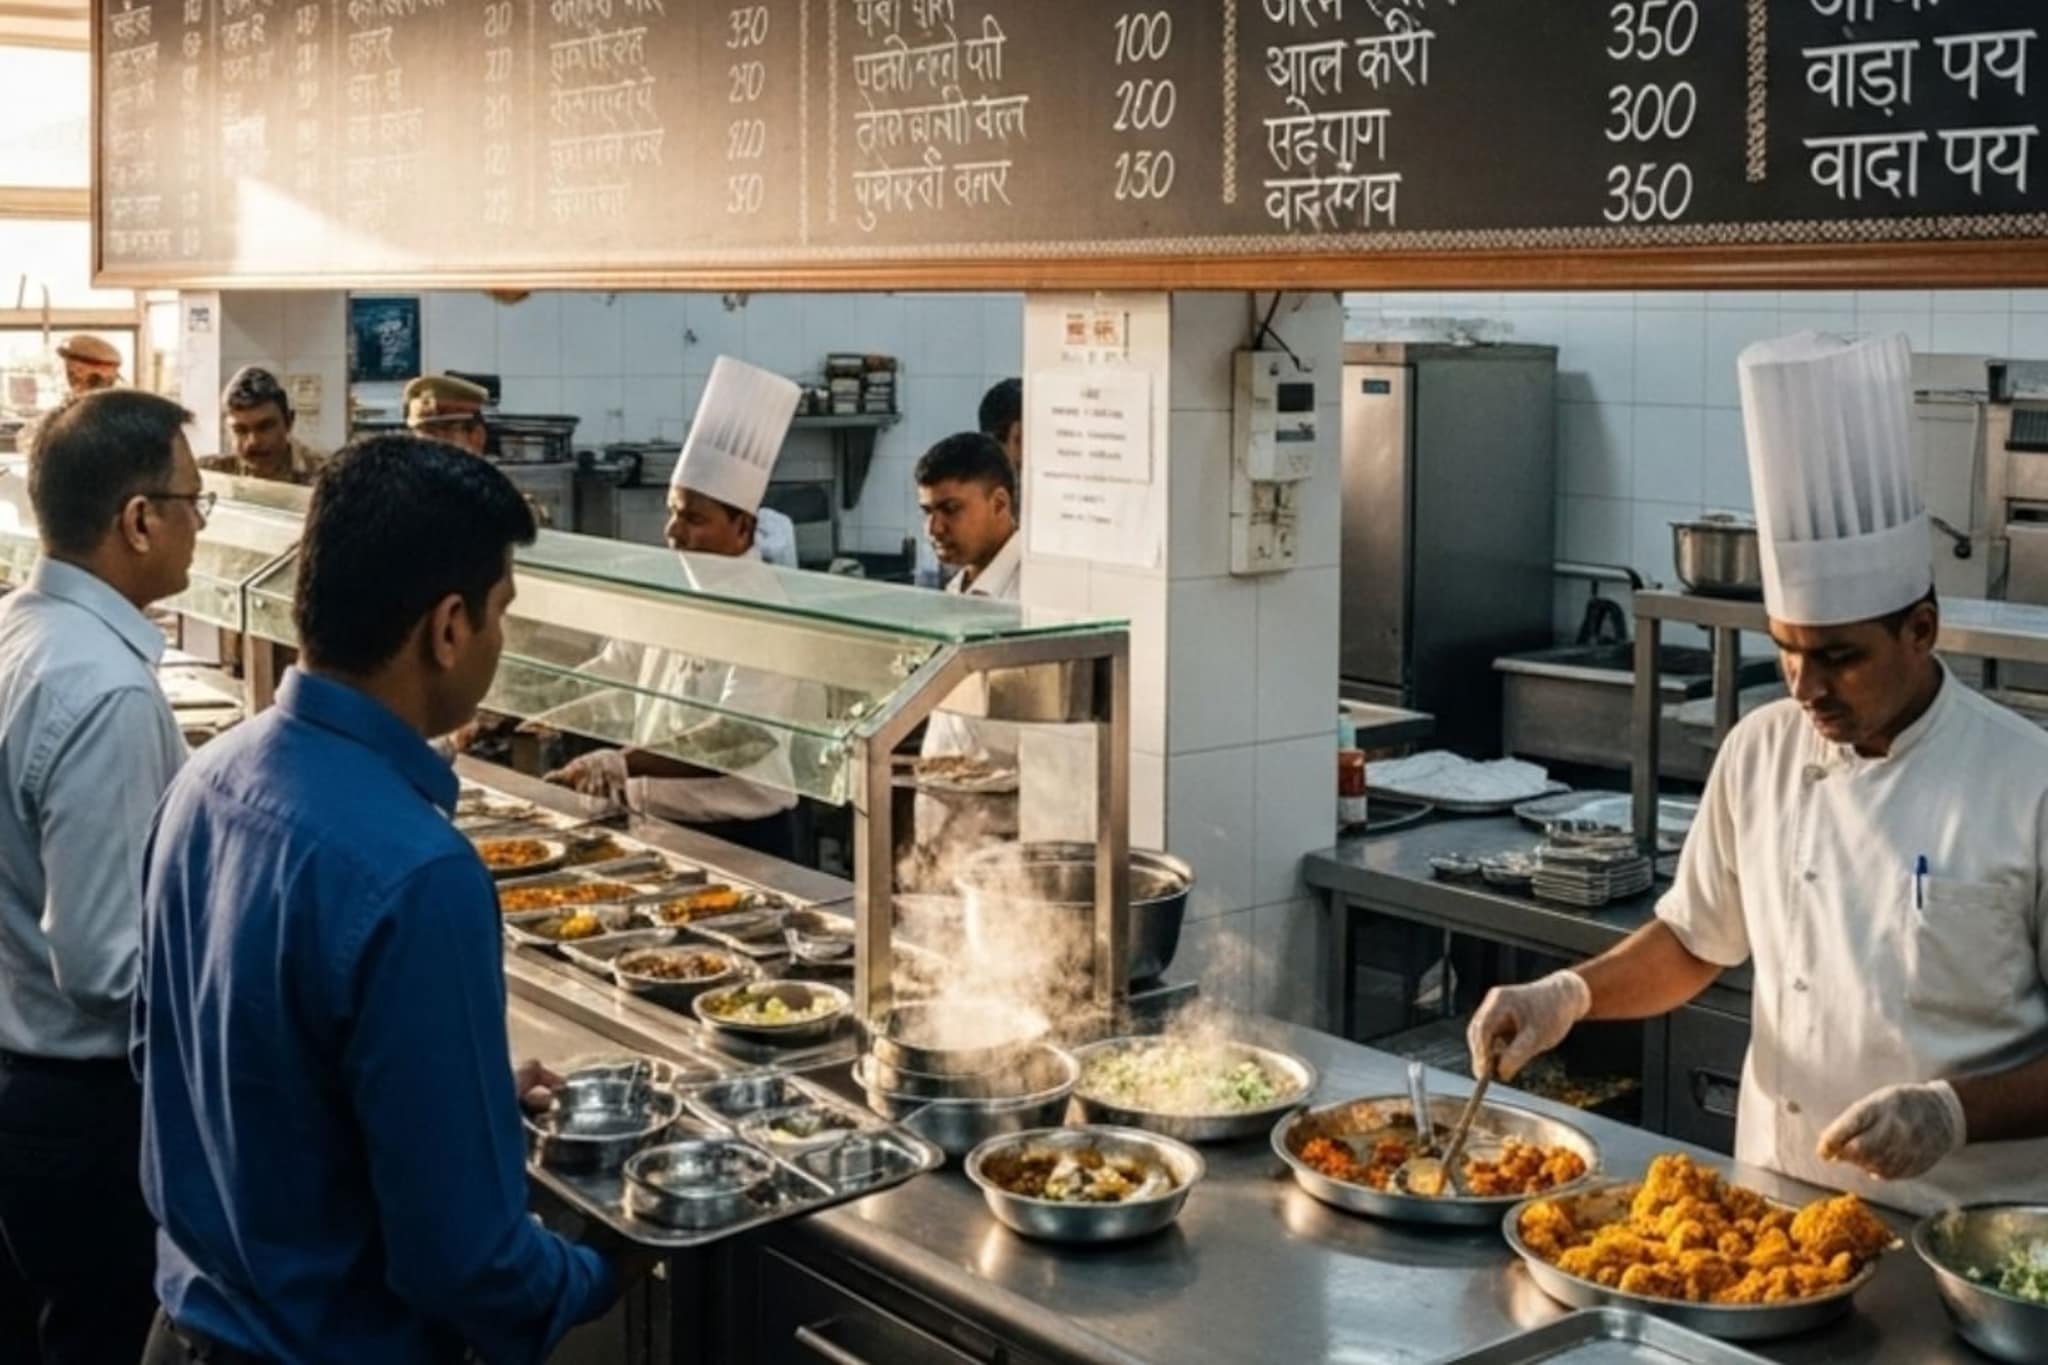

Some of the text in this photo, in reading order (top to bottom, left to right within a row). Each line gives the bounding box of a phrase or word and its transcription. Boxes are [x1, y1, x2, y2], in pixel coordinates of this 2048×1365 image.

[1114, 10, 1173, 65] 100
[1606, 0, 1699, 61] 350
[1932, 28, 2038, 100] पय
[1605, 81, 1697, 142] 300
[1803, 124, 2040, 200] वादा पय
